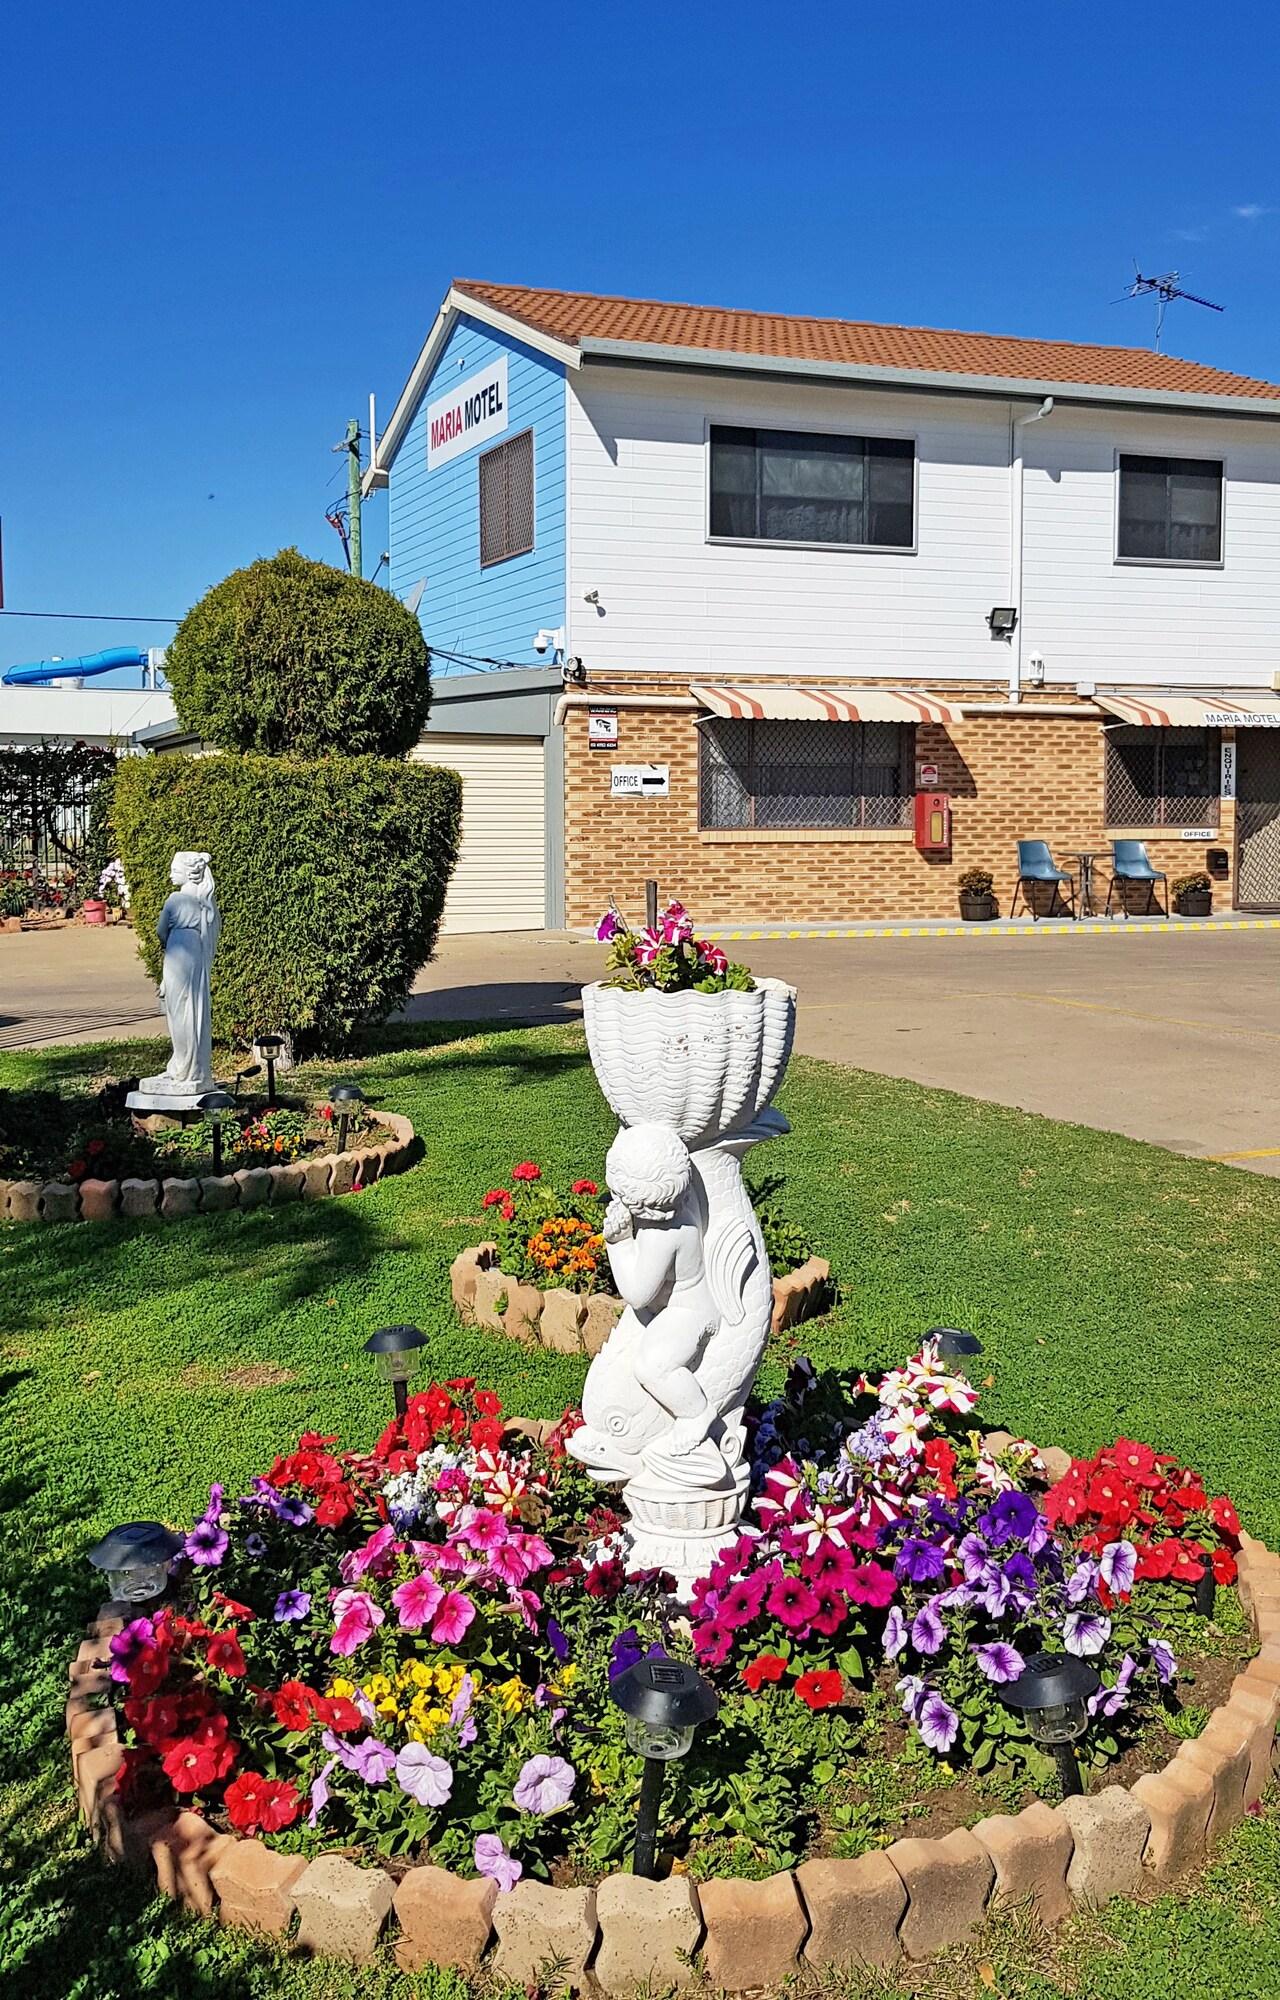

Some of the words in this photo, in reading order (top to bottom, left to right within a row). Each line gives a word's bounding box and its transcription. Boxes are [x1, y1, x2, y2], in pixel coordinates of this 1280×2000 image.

[431, 405, 463, 451] MARIA
[464, 381, 503, 431] MOTEL
[1205, 714, 1241, 723] MARIA
[1243, 714, 1280, 724] MOTEL
[613, 775, 639, 787] OFFICE
[1224, 747, 1232, 796] ENQUIRIES
